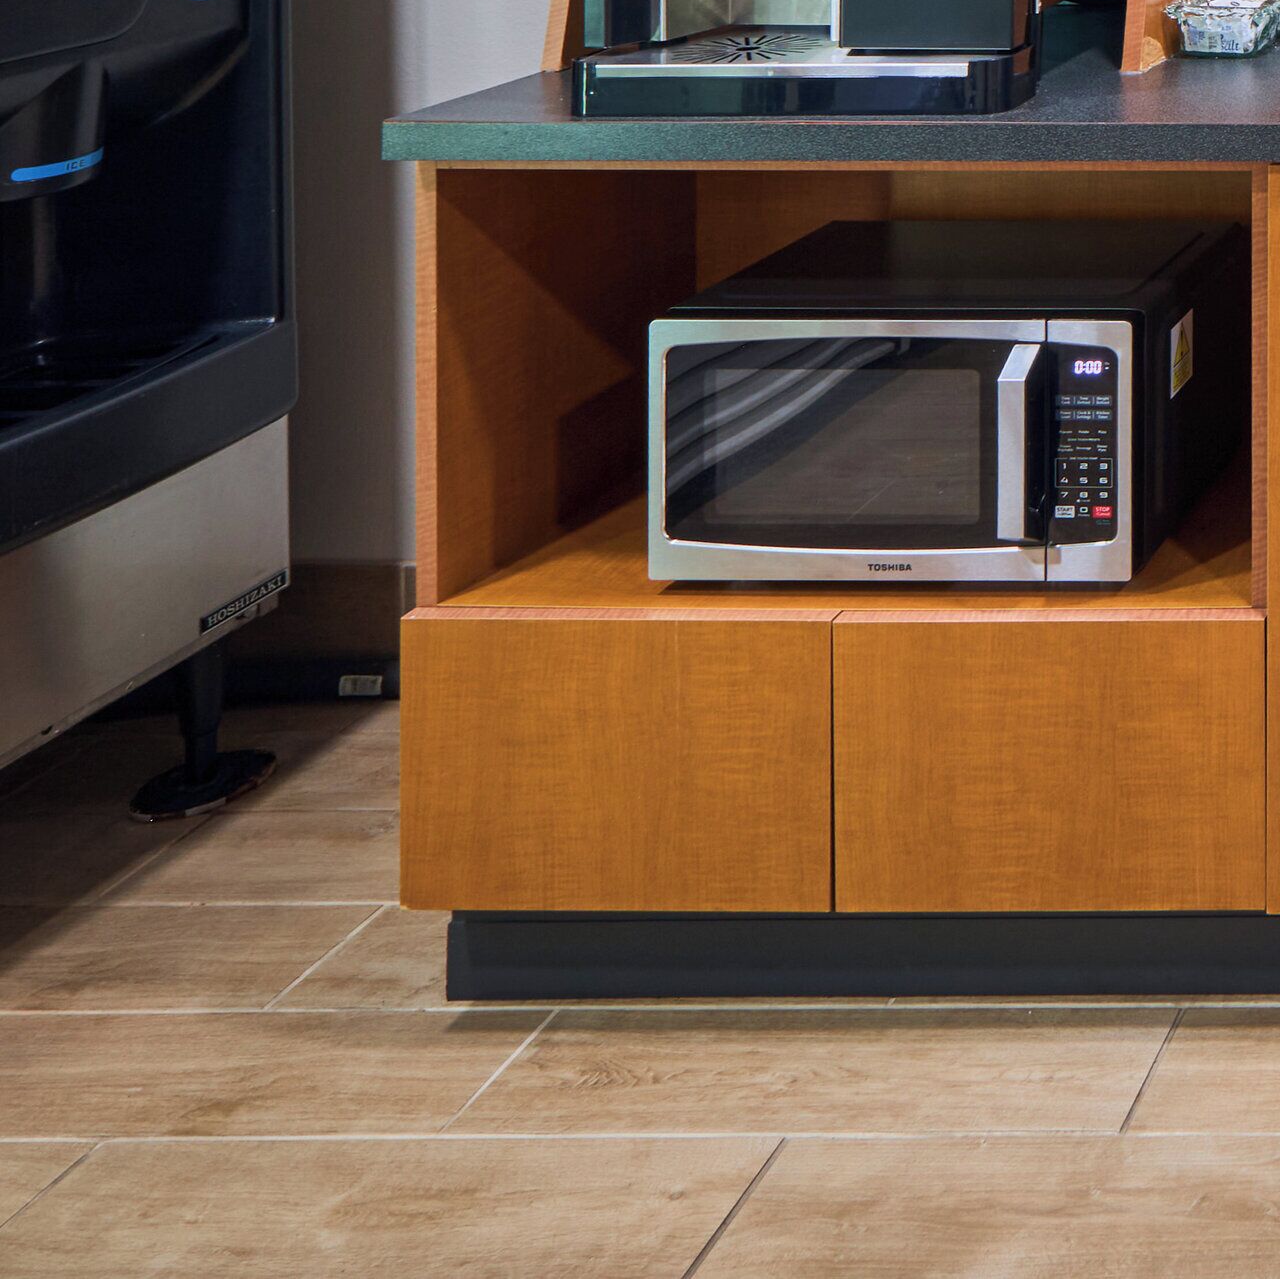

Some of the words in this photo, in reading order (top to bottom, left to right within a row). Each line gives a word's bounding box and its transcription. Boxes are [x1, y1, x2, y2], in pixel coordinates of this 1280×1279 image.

[1074, 360, 1102, 375] 0:00
[867, 563, 913, 572] TOSHIBA
[207, 575, 283, 628] HOSHIZAKI
